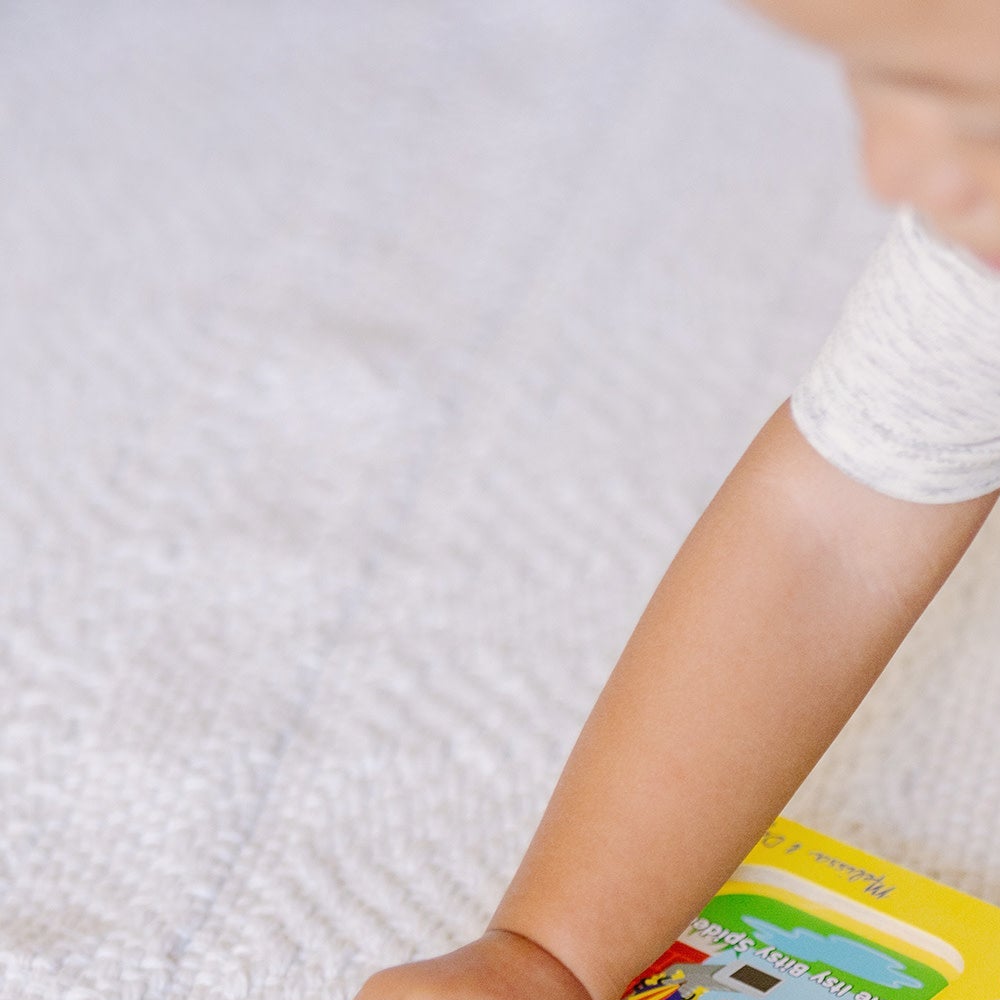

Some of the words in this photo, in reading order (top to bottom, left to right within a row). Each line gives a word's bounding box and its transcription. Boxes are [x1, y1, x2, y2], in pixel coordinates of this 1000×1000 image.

[690, 917, 756, 953] Spide
[754, 945, 809, 979] Bitsy
[809, 970, 853, 998] Itsy
